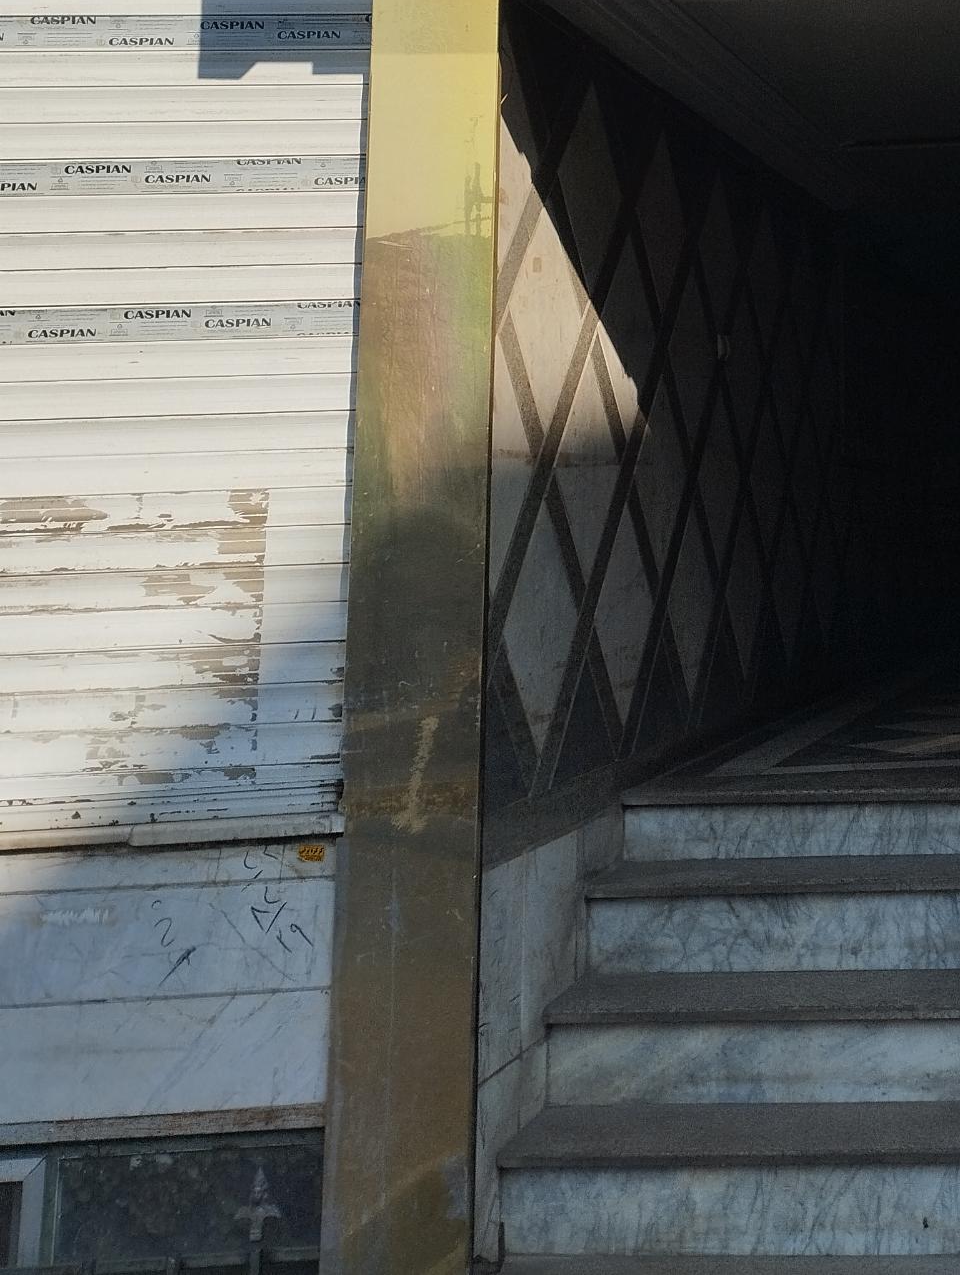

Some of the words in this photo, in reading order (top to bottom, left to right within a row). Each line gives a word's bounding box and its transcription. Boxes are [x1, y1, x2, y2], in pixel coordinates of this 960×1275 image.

[30, 16, 97, 25] CASPIAN
[201, 20, 265, 30] CASPIAN
[278, 30, 341, 40] CASPIAN
[108, 37, 175, 46] CASPIAN
[64, 164, 132, 175] CASPIAN
[144, 174, 211, 184] CASPIAN
[123, 309, 192, 320] CASPIAN
[204, 317, 272, 329] CASPIAN
[27, 328, 97, 339] CASPIAN
